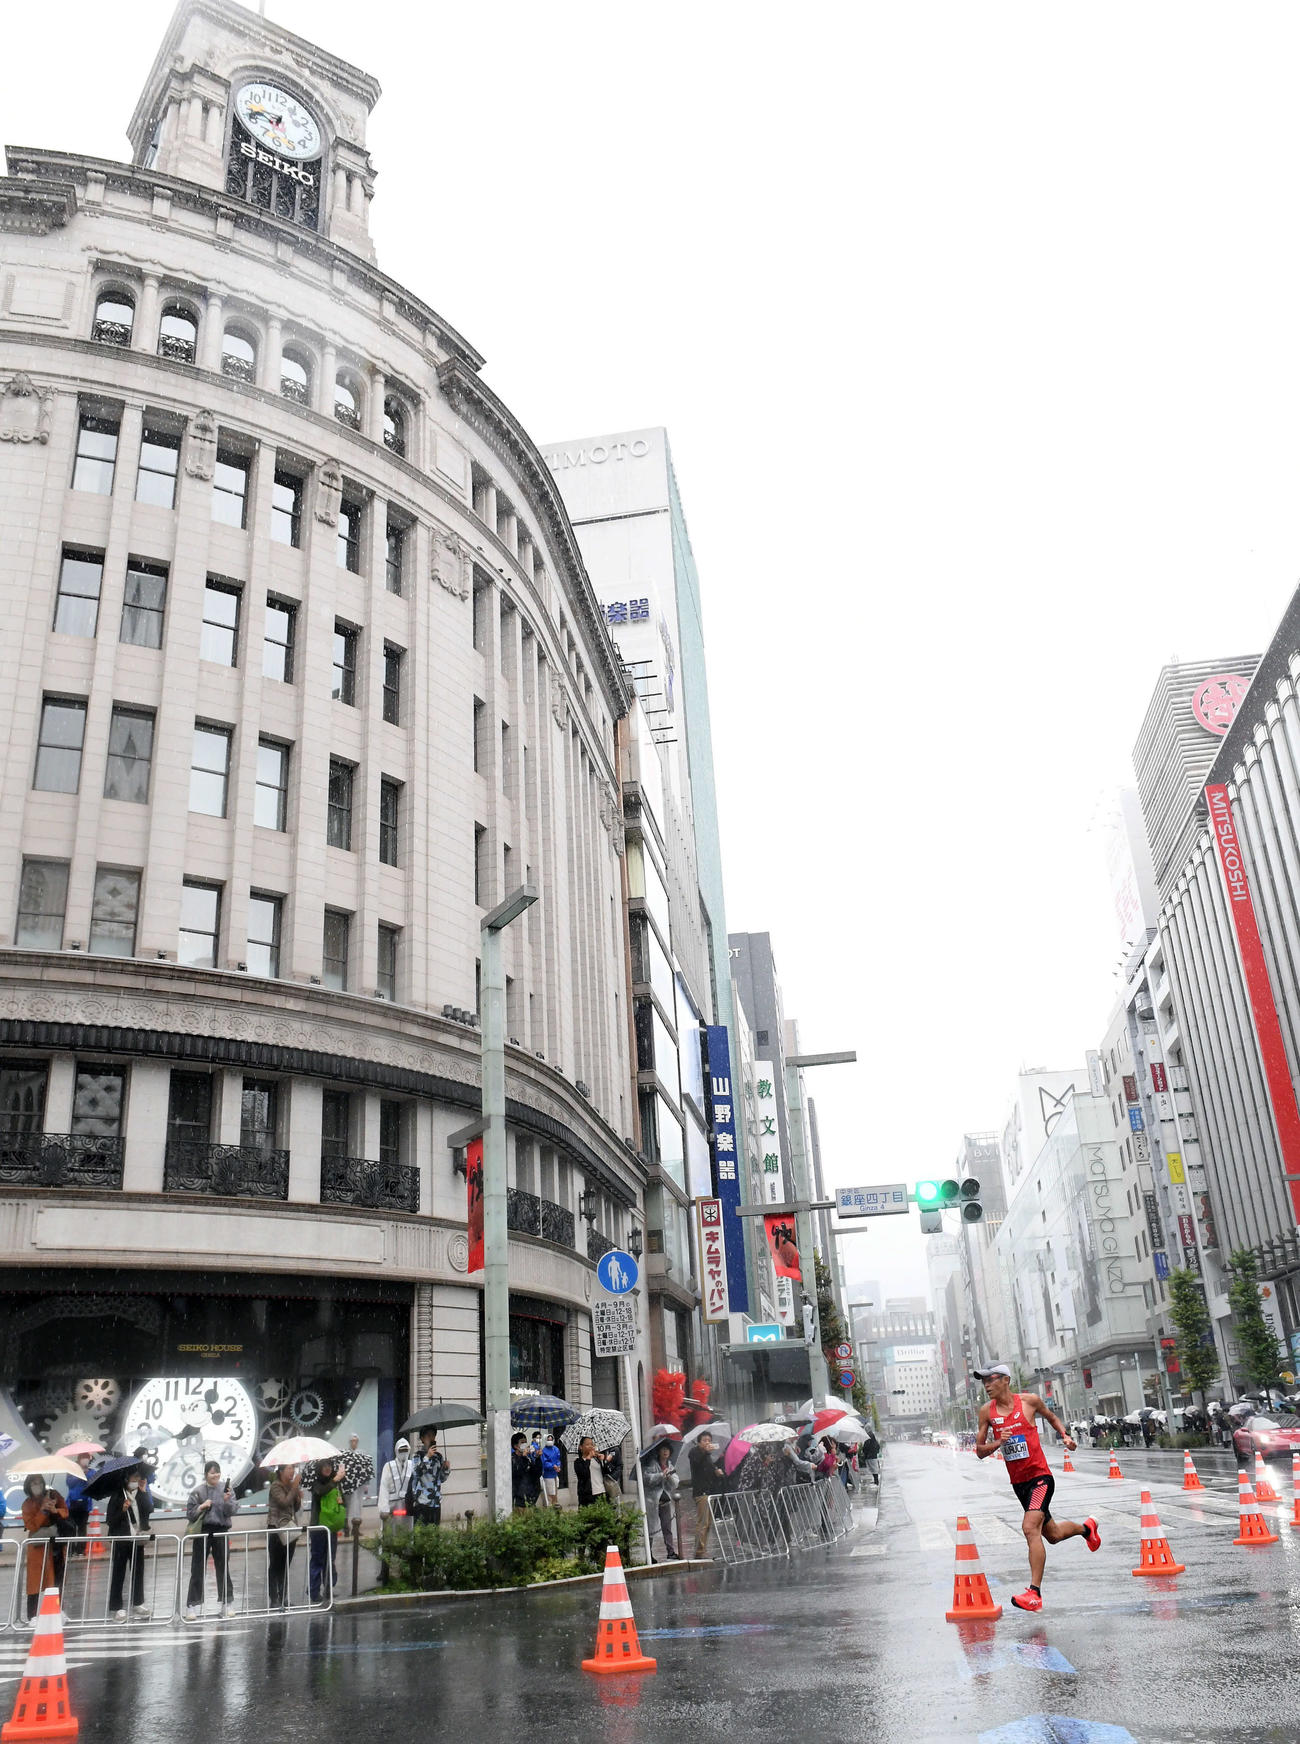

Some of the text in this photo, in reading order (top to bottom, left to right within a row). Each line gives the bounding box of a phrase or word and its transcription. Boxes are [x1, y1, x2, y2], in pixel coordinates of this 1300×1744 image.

[240, 142, 313, 186] SEIKO
[1210, 791, 1248, 902] MITSUKOSHI
[712, 1076, 737, 1180] 山野楽器
[757, 1078, 779, 1174] 教文館
[841, 1192, 903, 1206] 銀座四丁目
[705, 1230, 725, 1314] キムラヤのパン
[177, 1344, 243, 1352] SEIKO HOUSE
[165, 1380, 179, 1402] 11
[185, 1378, 204, 1396] 12
[146, 1398, 163, 1420] 10
[224, 1396, 238, 1417] 2
[230, 1420, 244, 1440] 3
[182, 1466, 196, 1489] 6
